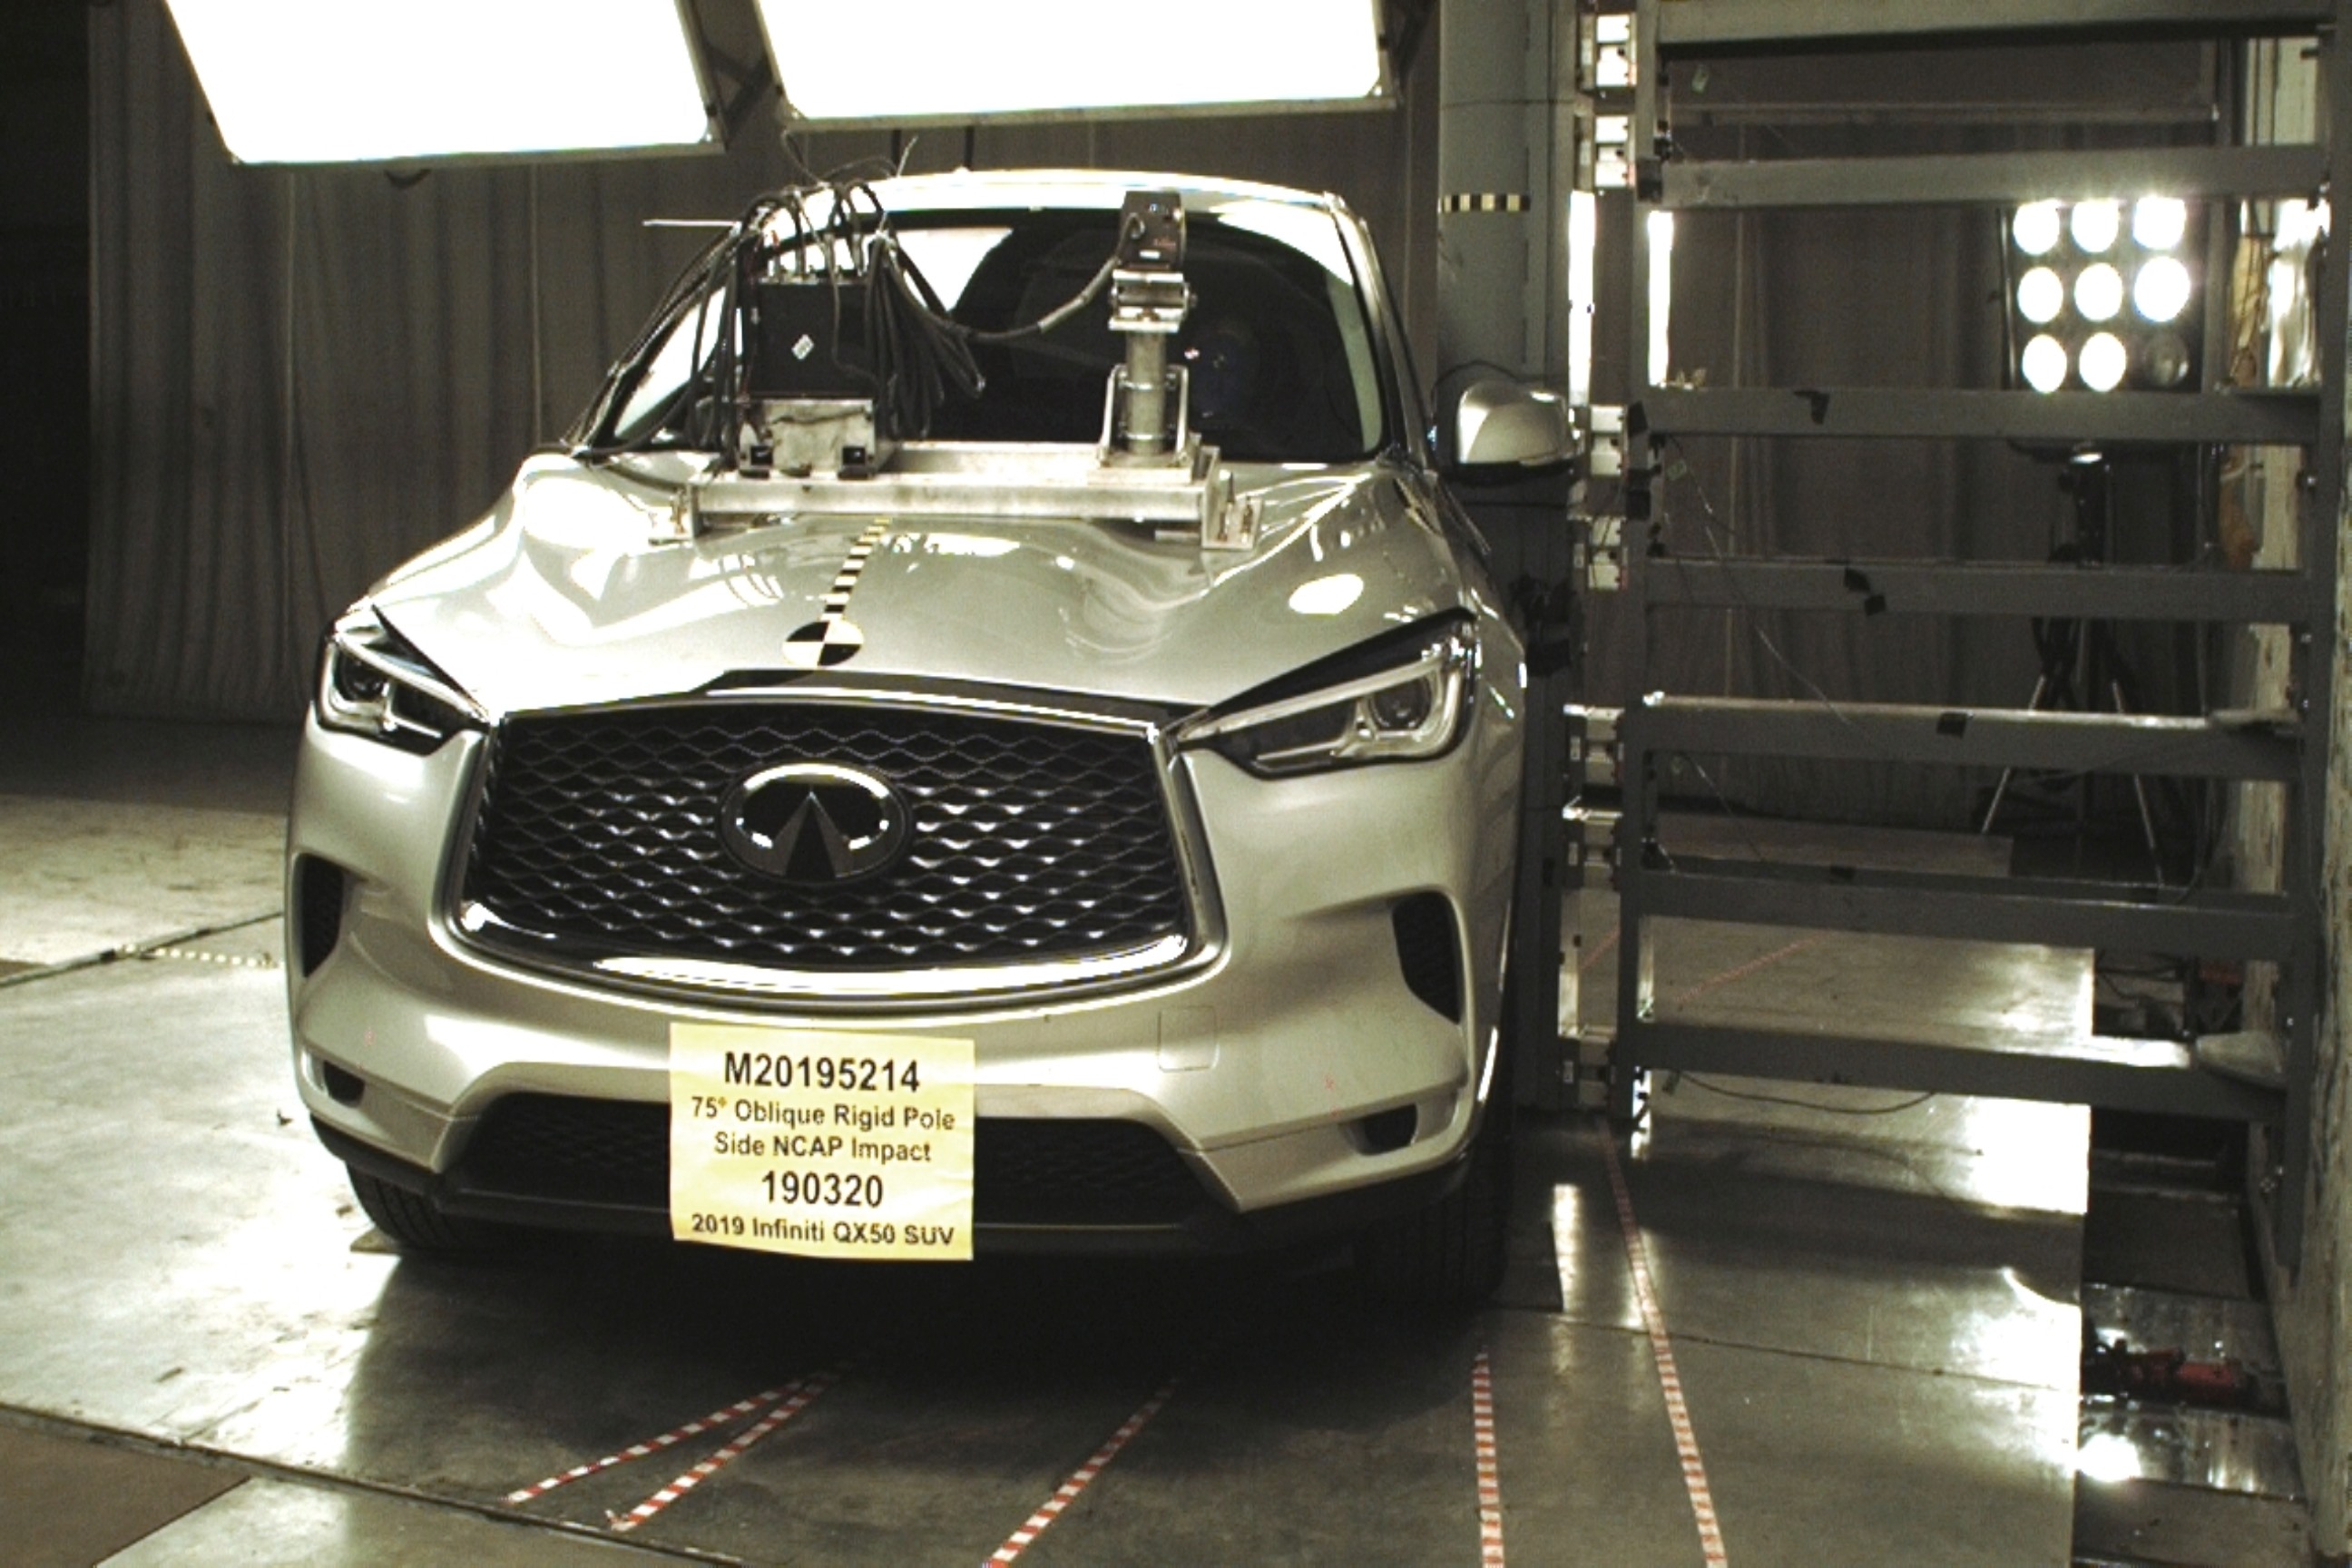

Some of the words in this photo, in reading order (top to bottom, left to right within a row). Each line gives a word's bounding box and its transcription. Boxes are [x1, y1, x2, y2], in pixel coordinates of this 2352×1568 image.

[724, 1052, 921, 1093] M20195214
[735, 1100, 826, 1130] Oblique
[834, 1103, 895, 1132] Rigid
[904, 1107, 956, 1131] Pole
[714, 1132, 766, 1157] Side
[773, 1135, 843, 1158] NCAP
[851, 1139, 931, 1165] Impact
[762, 1170, 884, 1208] 190320
[691, 1214, 745, 1235] 2019
[752, 1218, 825, 1241] Infiniti
[833, 1220, 896, 1244] QX50
[904, 1225, 956, 1246] SUV
